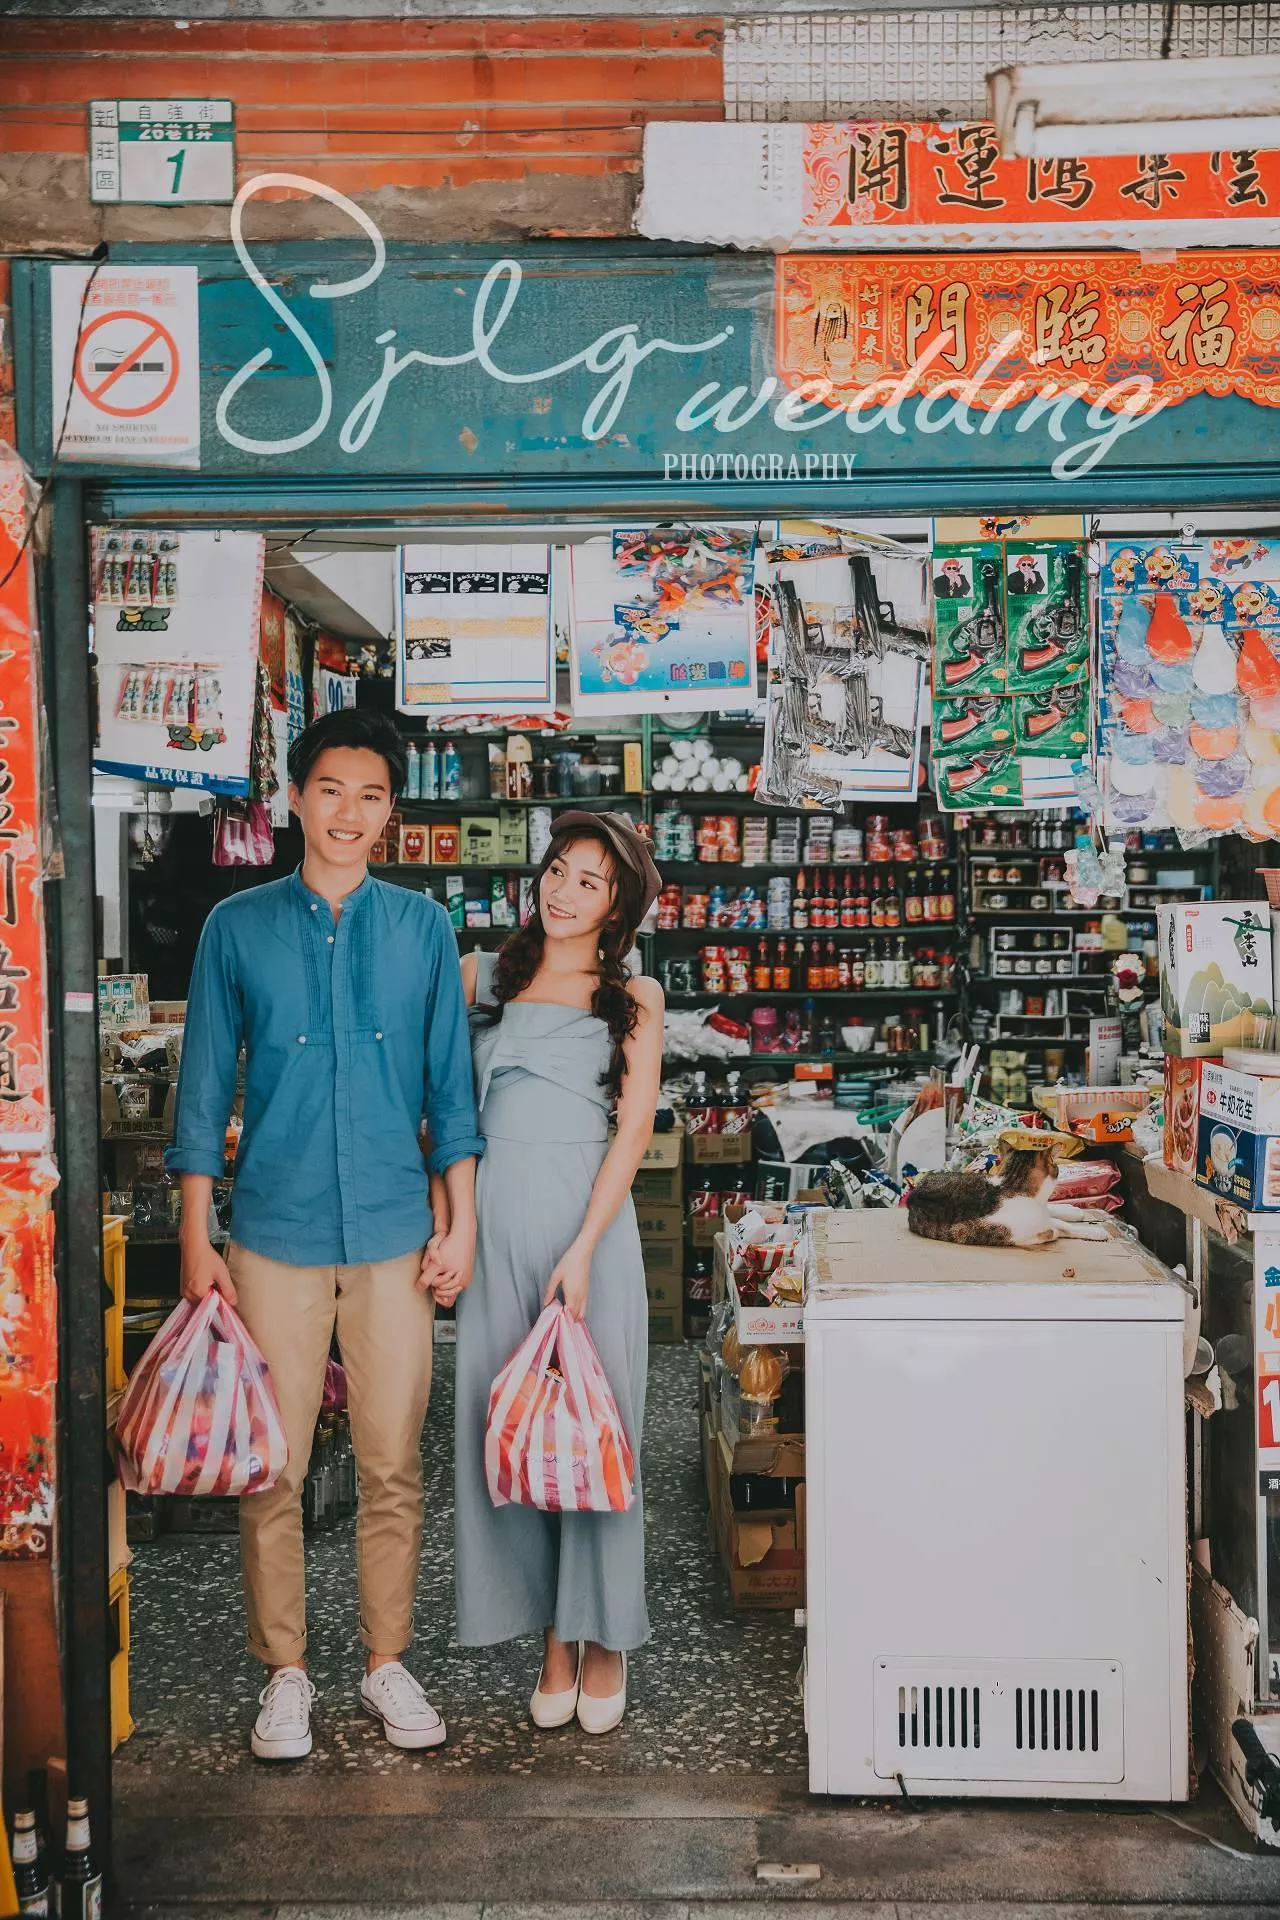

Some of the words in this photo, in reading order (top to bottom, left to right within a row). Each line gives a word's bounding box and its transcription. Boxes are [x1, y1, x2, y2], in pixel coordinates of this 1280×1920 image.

[166, 149, 186, 194] 1
[859, 284, 884, 357] 好運來
[1219, 1091, 1253, 1121] 牛奶花生
